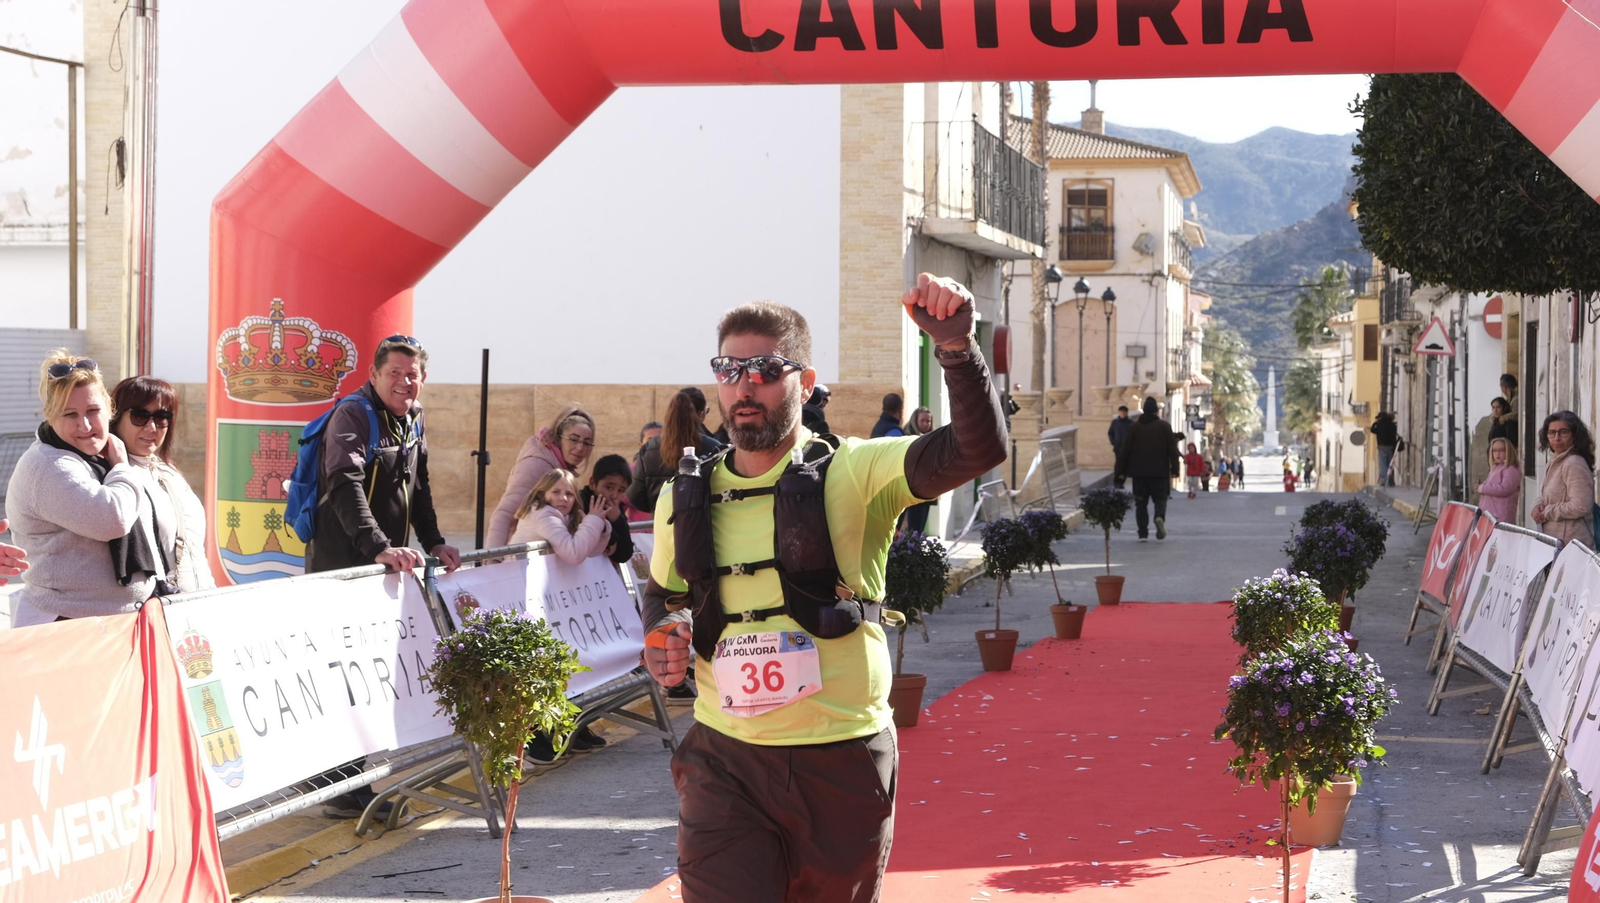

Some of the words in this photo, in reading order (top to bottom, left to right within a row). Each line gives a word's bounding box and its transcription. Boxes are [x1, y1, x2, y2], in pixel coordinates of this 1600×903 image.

[594, 580, 610, 600] DE
[233, 619, 389, 672] AYUNAENTO
[394, 615, 417, 640] DE
[551, 606, 630, 652] TORIA
[726, 637, 737, 647] IV
[736, 634, 758, 646] CxM
[721, 648, 732, 658] LA
[733, 645, 778, 657] PÓLVORA
[242, 650, 434, 738] CANTORIA
[740, 660, 785, 695] 36
